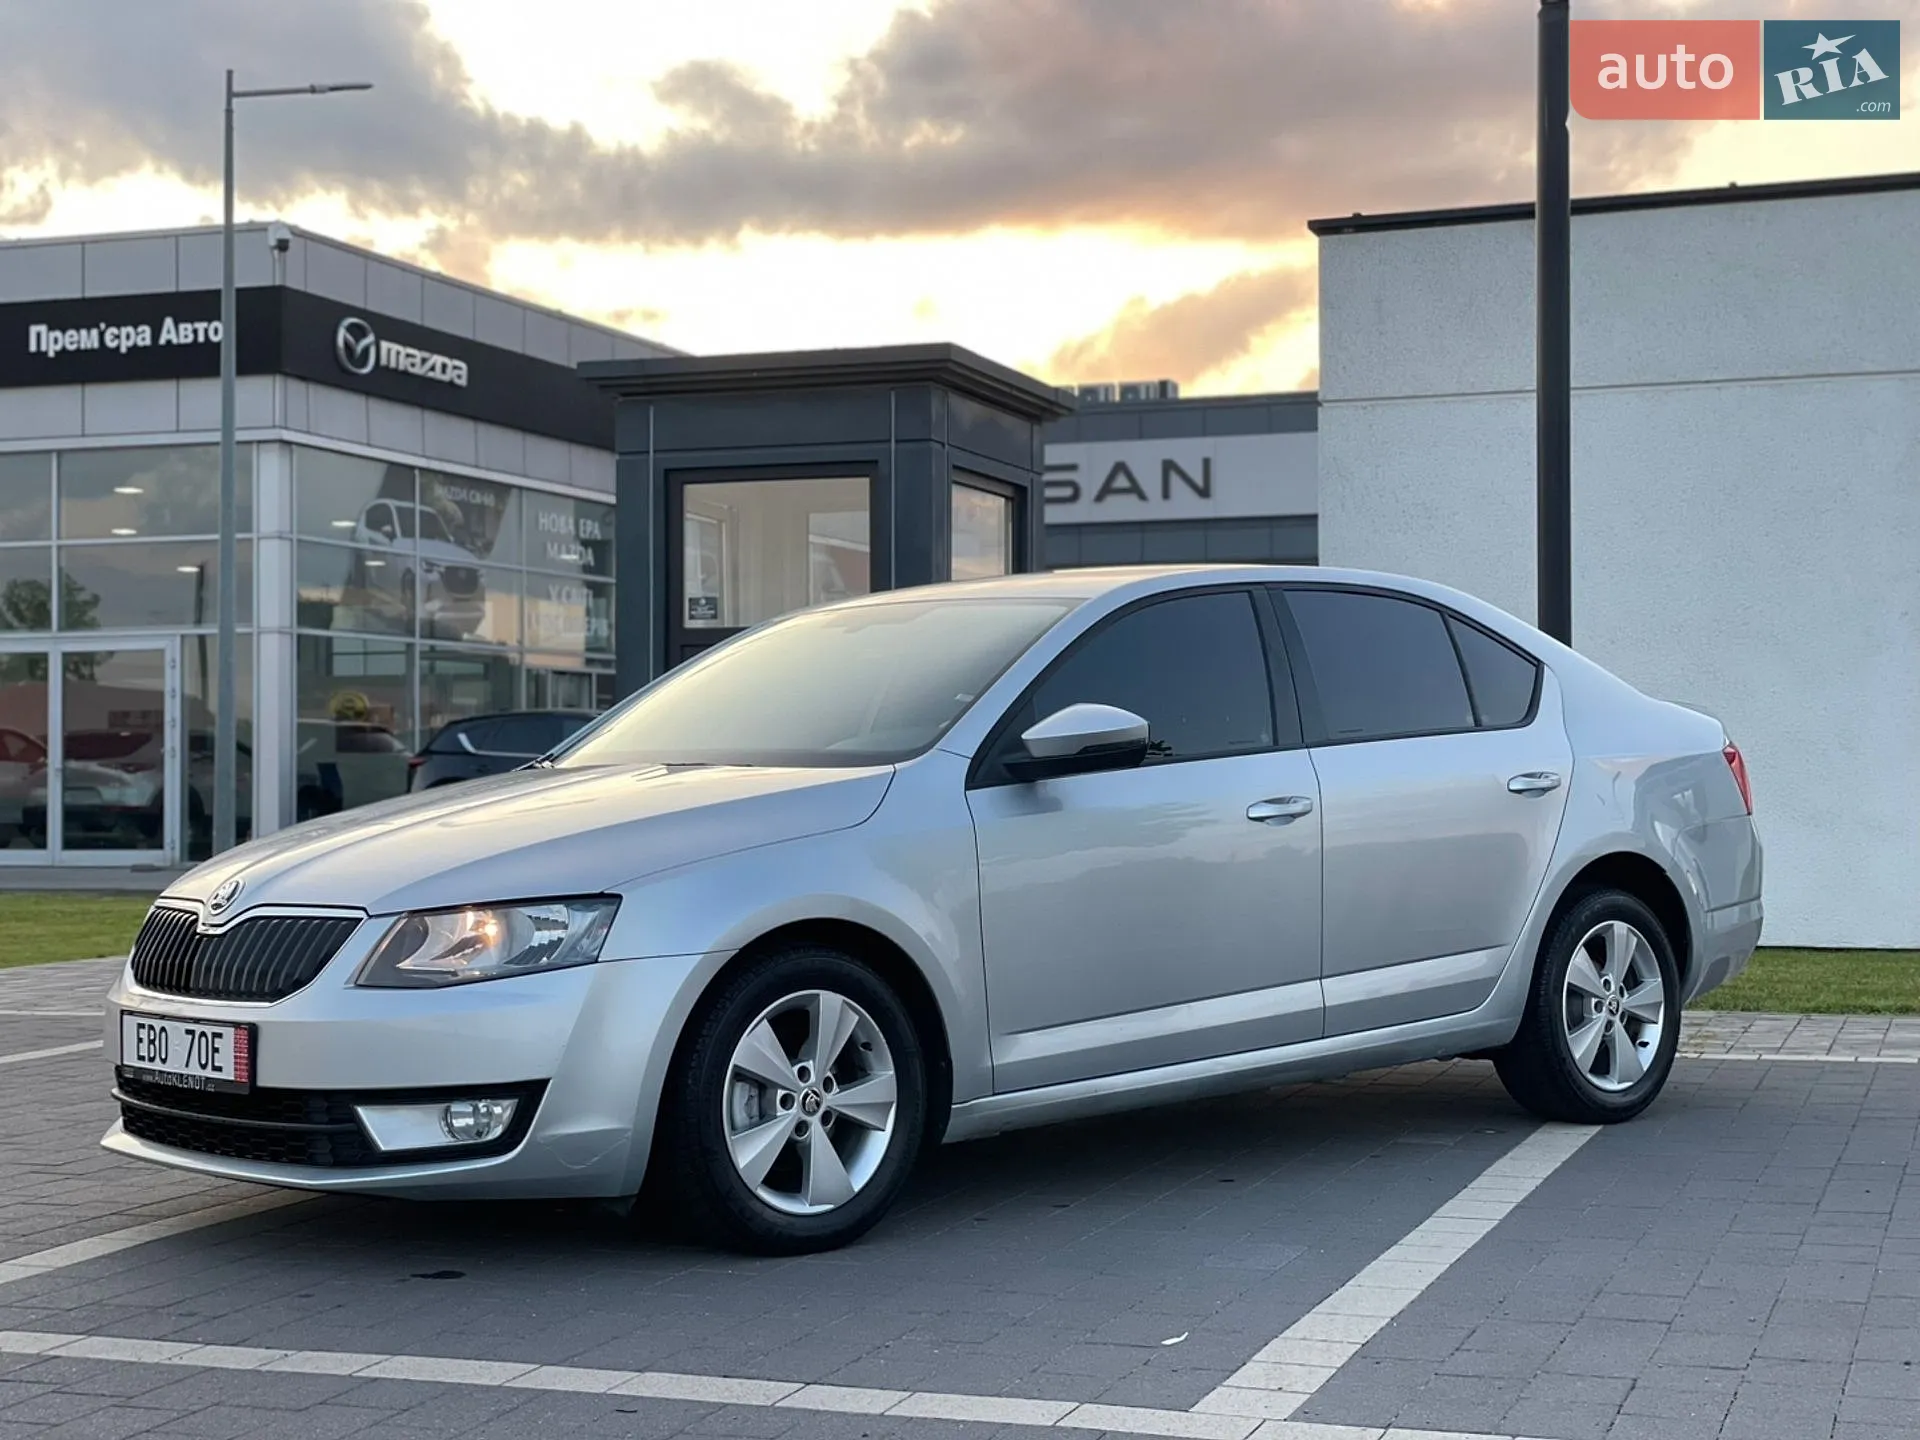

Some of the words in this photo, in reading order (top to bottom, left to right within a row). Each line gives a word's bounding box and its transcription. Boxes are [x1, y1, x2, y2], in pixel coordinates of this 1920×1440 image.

[28, 322, 151, 358] Прем'єра
[158, 316, 224, 346] Авто
[379, 339, 469, 388] mazda
